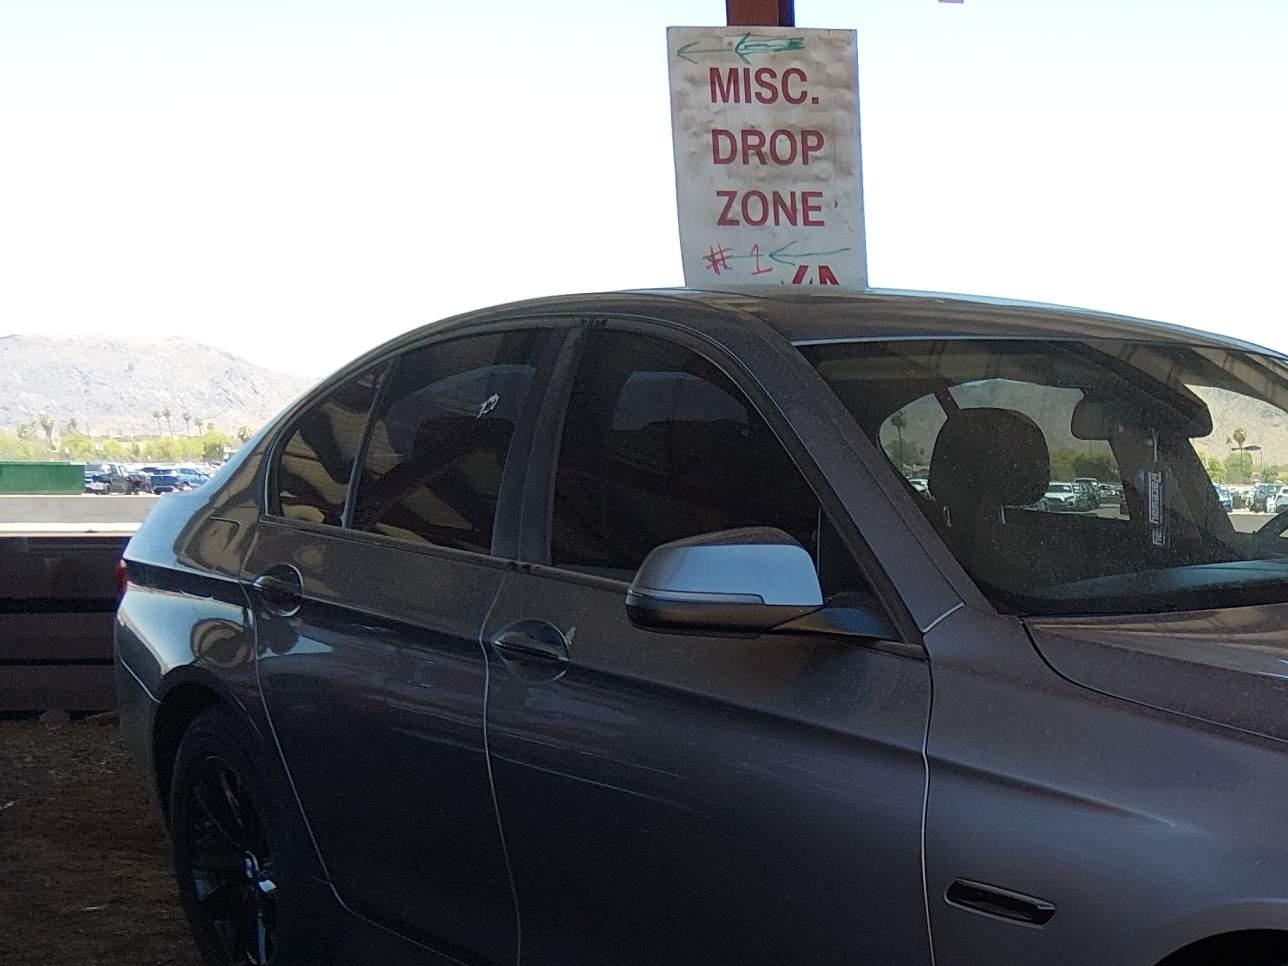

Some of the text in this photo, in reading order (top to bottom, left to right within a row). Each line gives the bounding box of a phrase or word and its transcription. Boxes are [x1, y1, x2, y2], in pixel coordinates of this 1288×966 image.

[709, 67, 820, 105] MISC.
[711, 129, 825, 166] DROP
[716, 190, 826, 228] ZONE
